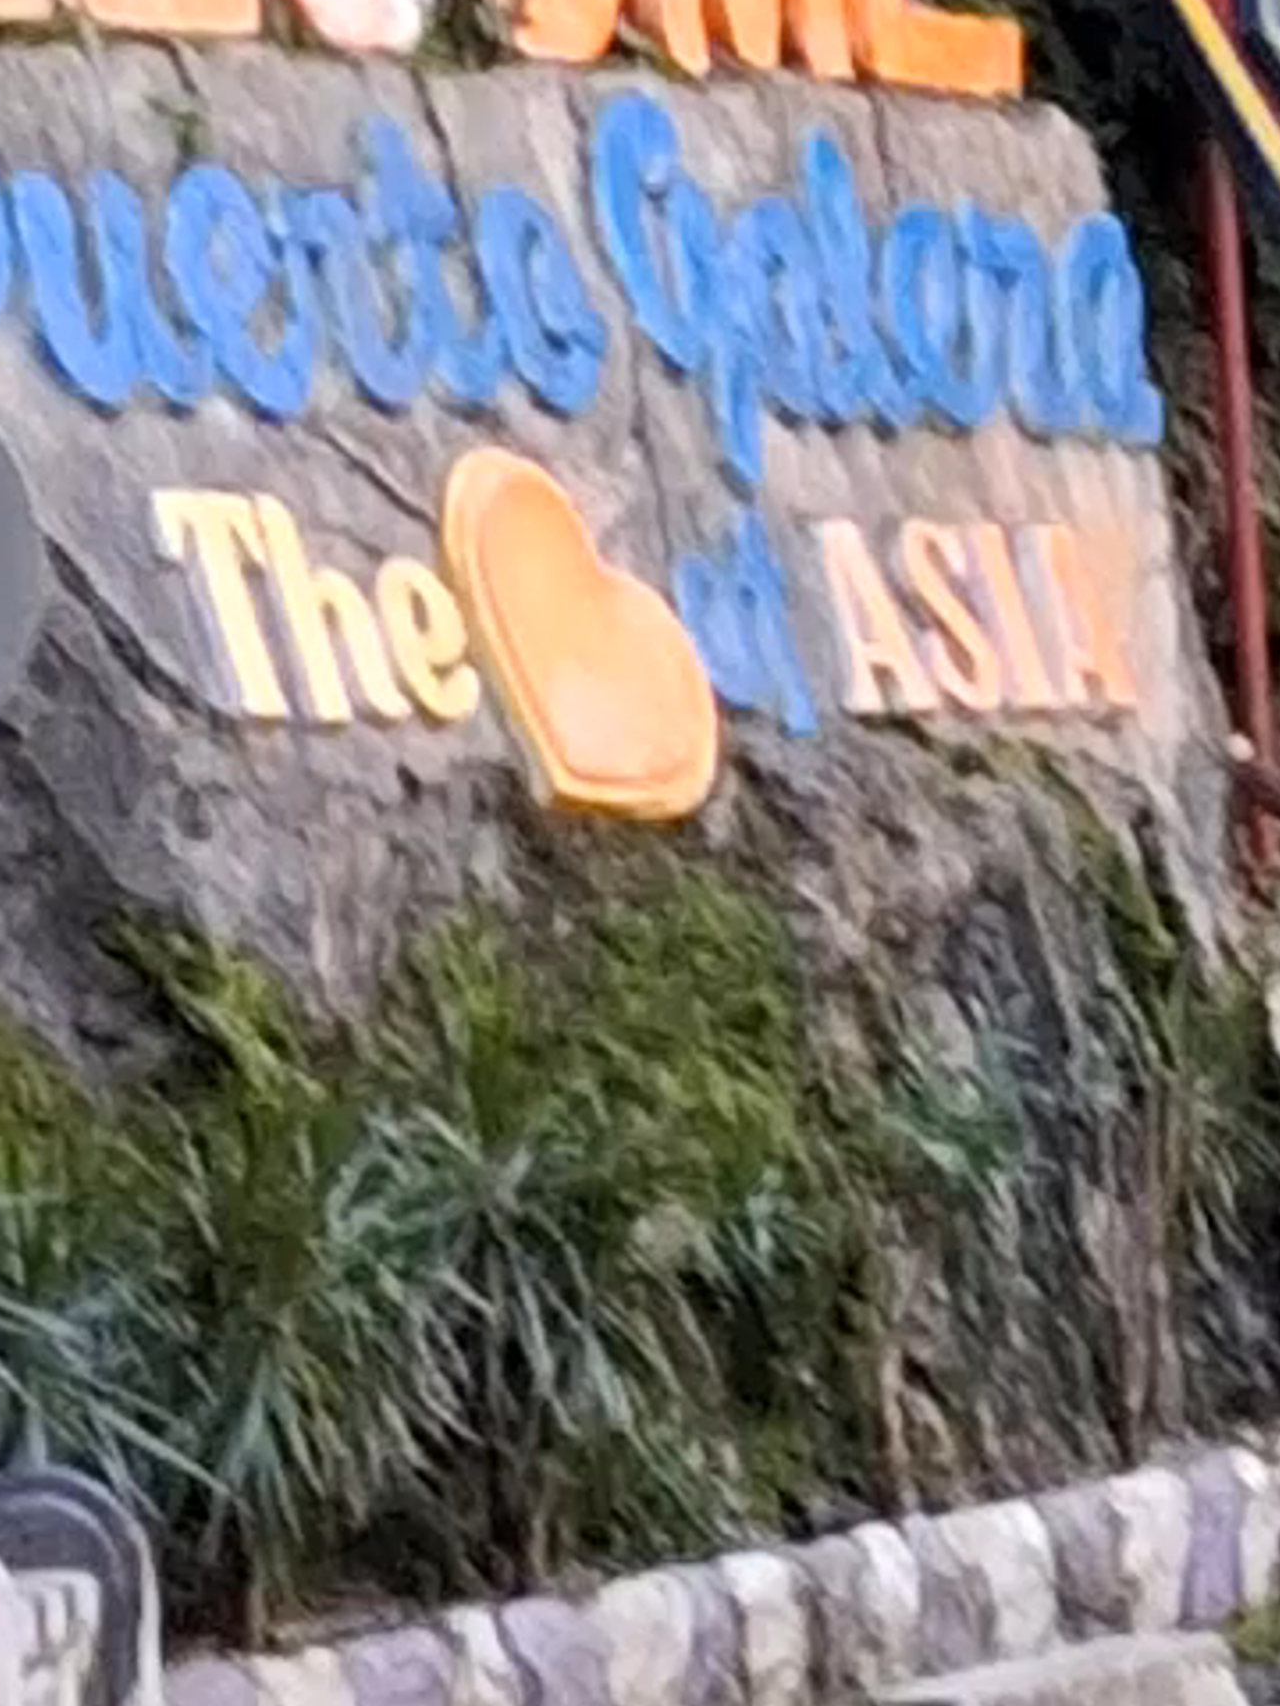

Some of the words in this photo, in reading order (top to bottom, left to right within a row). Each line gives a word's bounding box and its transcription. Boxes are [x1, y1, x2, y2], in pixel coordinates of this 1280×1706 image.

[592, 86, 1166, 488] Galera
[152, 488, 481, 722] The
[816, 516, 1140, 714] ASIA
